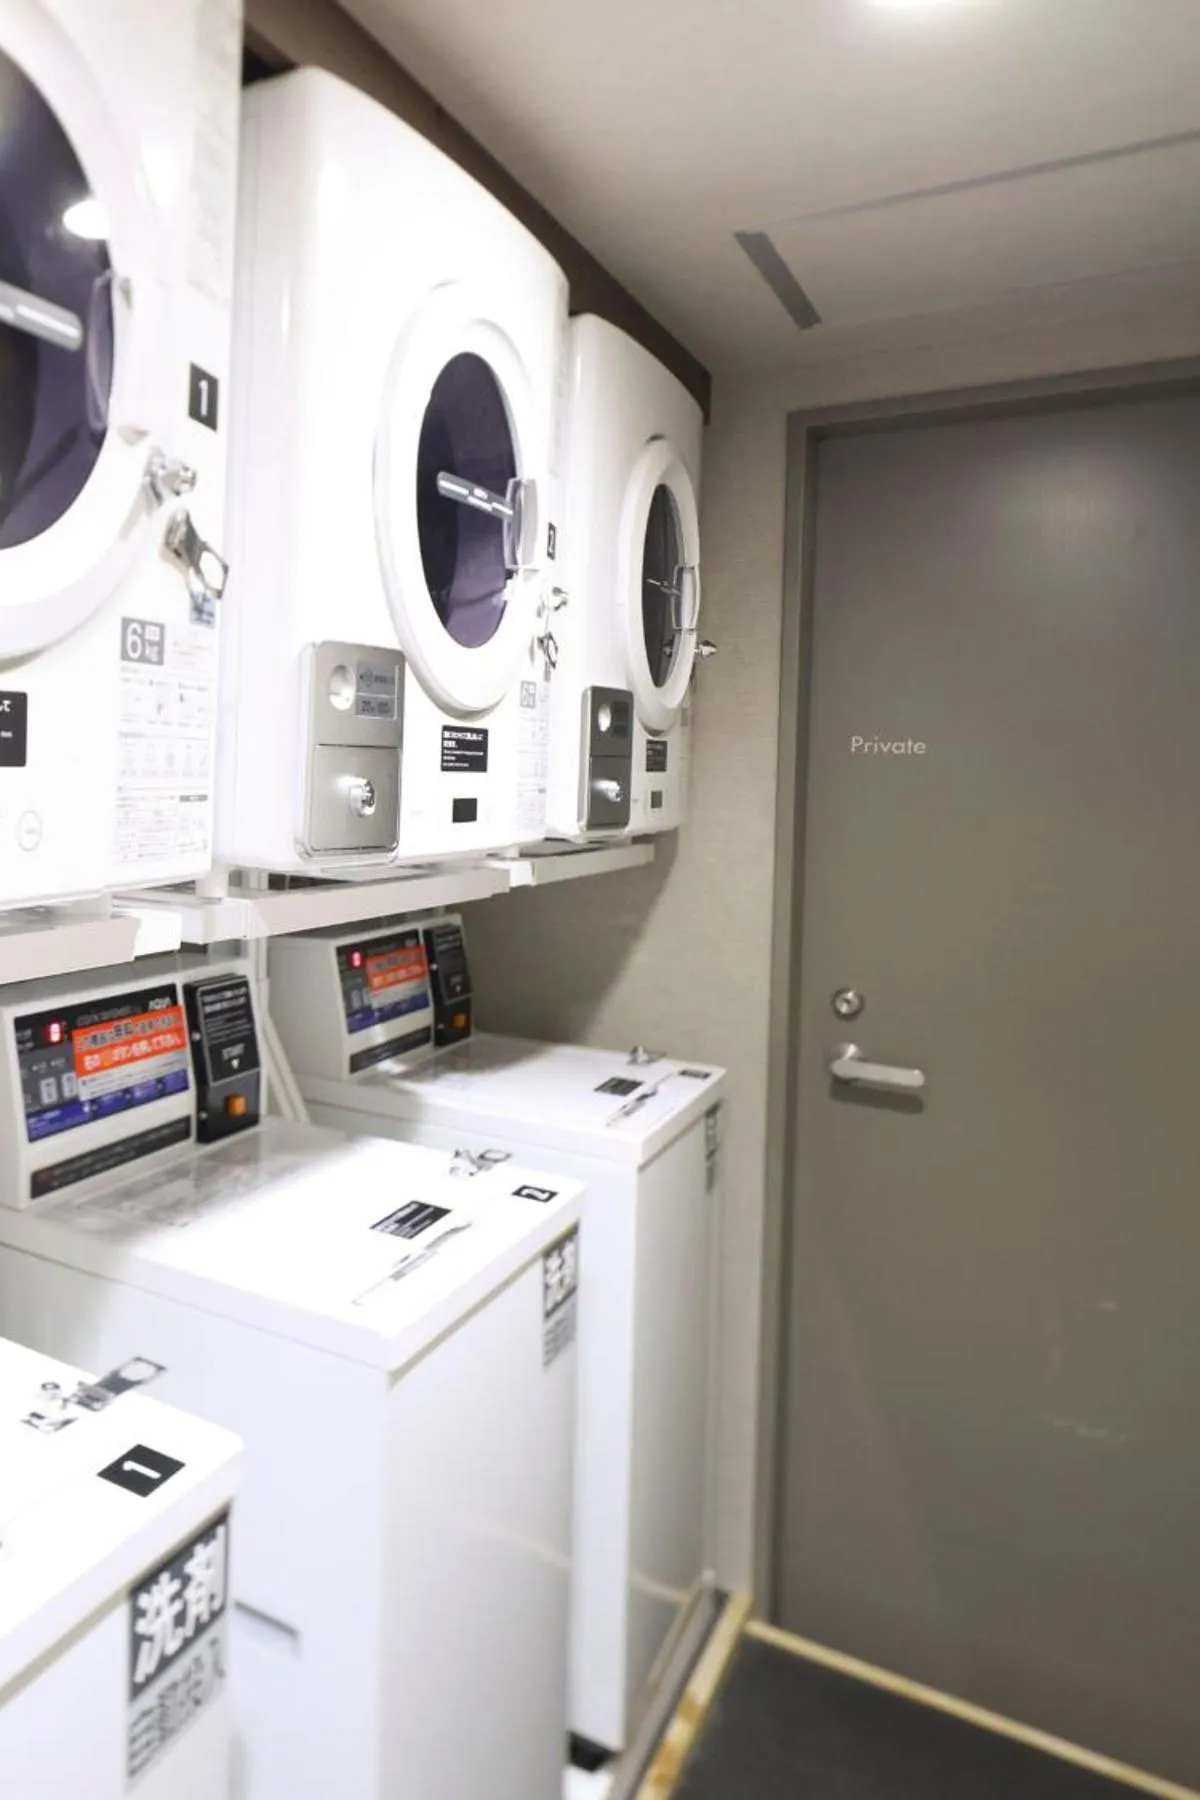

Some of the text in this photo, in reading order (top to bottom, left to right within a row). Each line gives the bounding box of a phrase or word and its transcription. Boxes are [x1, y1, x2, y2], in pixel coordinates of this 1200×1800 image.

[198, 379, 209, 418] 1
[850, 735, 927, 755] Private
[121, 1460, 162, 1480] 1
